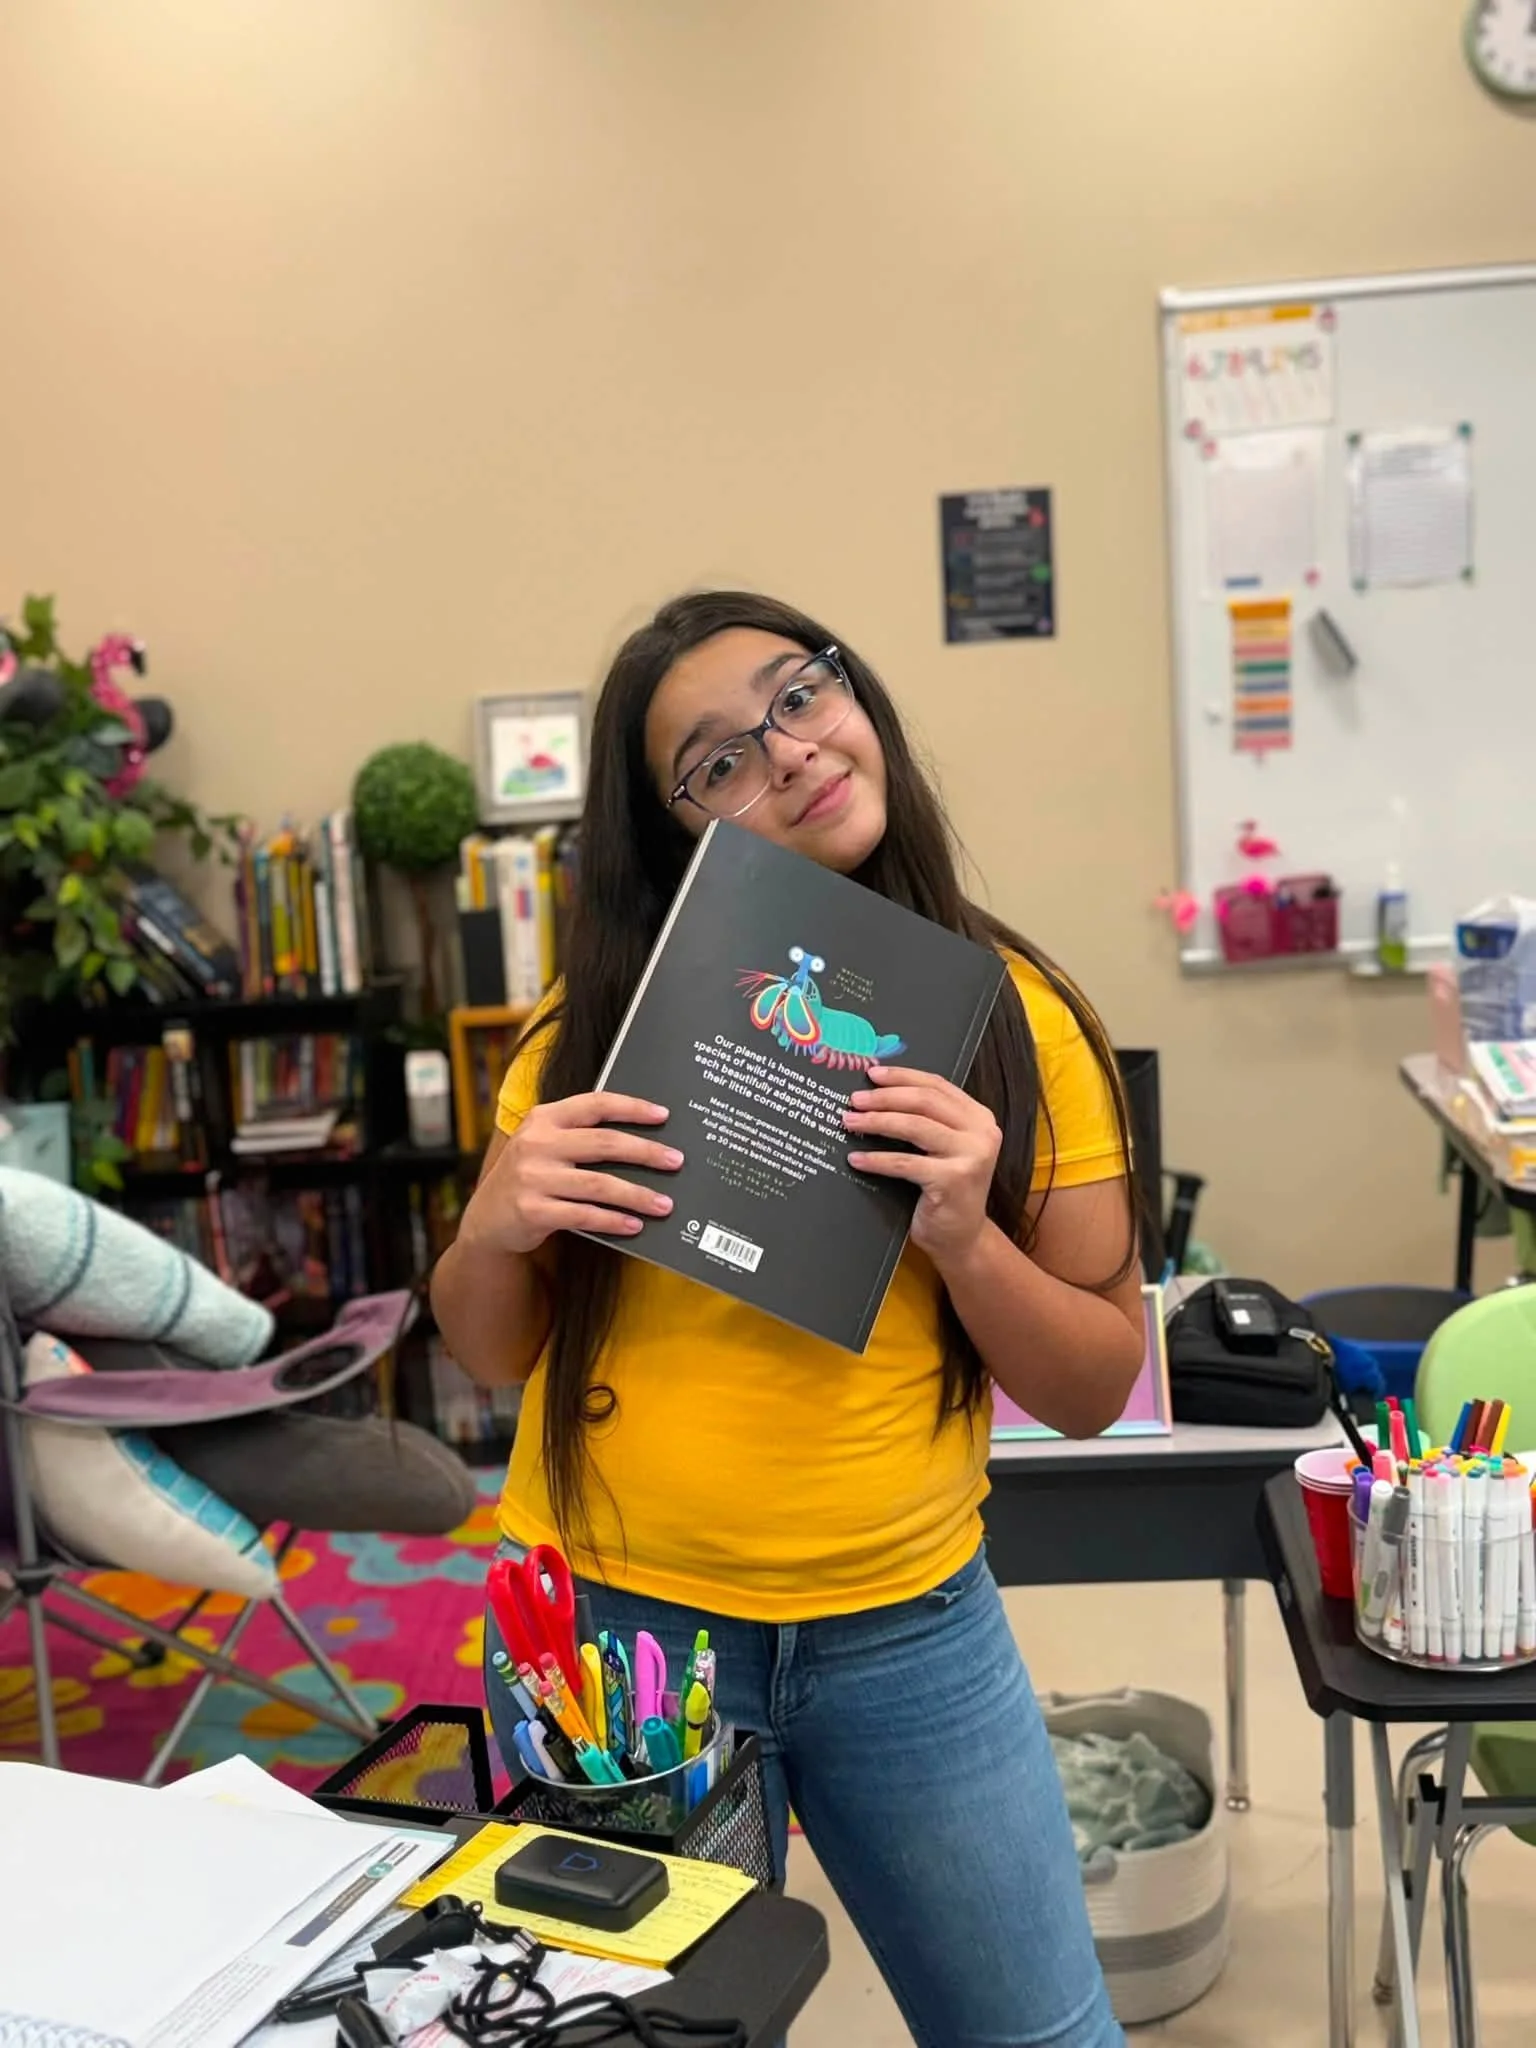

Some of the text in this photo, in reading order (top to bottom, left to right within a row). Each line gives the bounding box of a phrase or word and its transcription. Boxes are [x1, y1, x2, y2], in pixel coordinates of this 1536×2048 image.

[694, 1041, 836, 1111] species of wild and wonderful
[694, 1054, 720, 1070] each
[721, 1064, 773, 1095] beautifully
[773, 1089, 814, 1113] adapted
[814, 1108, 824, 1118] to
[714, 1034, 851, 1106] Our planet is home to countl
[688, 1099, 710, 1114] Learn
[711, 1110, 734, 1124] which
[734, 1120, 758, 1136] animal
[759, 1132, 784, 1148] sounds
[784, 1142, 798, 1154] like
[703, 1070, 848, 1144] their little corner of the world.
[710, 1096, 729, 1110] Meet
[736, 1110, 789, 1138] solar-powered
[789, 1134, 802, 1144] sea
[702, 1117, 818, 1176] And discover which creature can
[706, 1132, 717, 1141] go
[718, 1136, 728, 1146] 30
[728, 1142, 749, 1156] years
[750, 1150, 782, 1170] between
